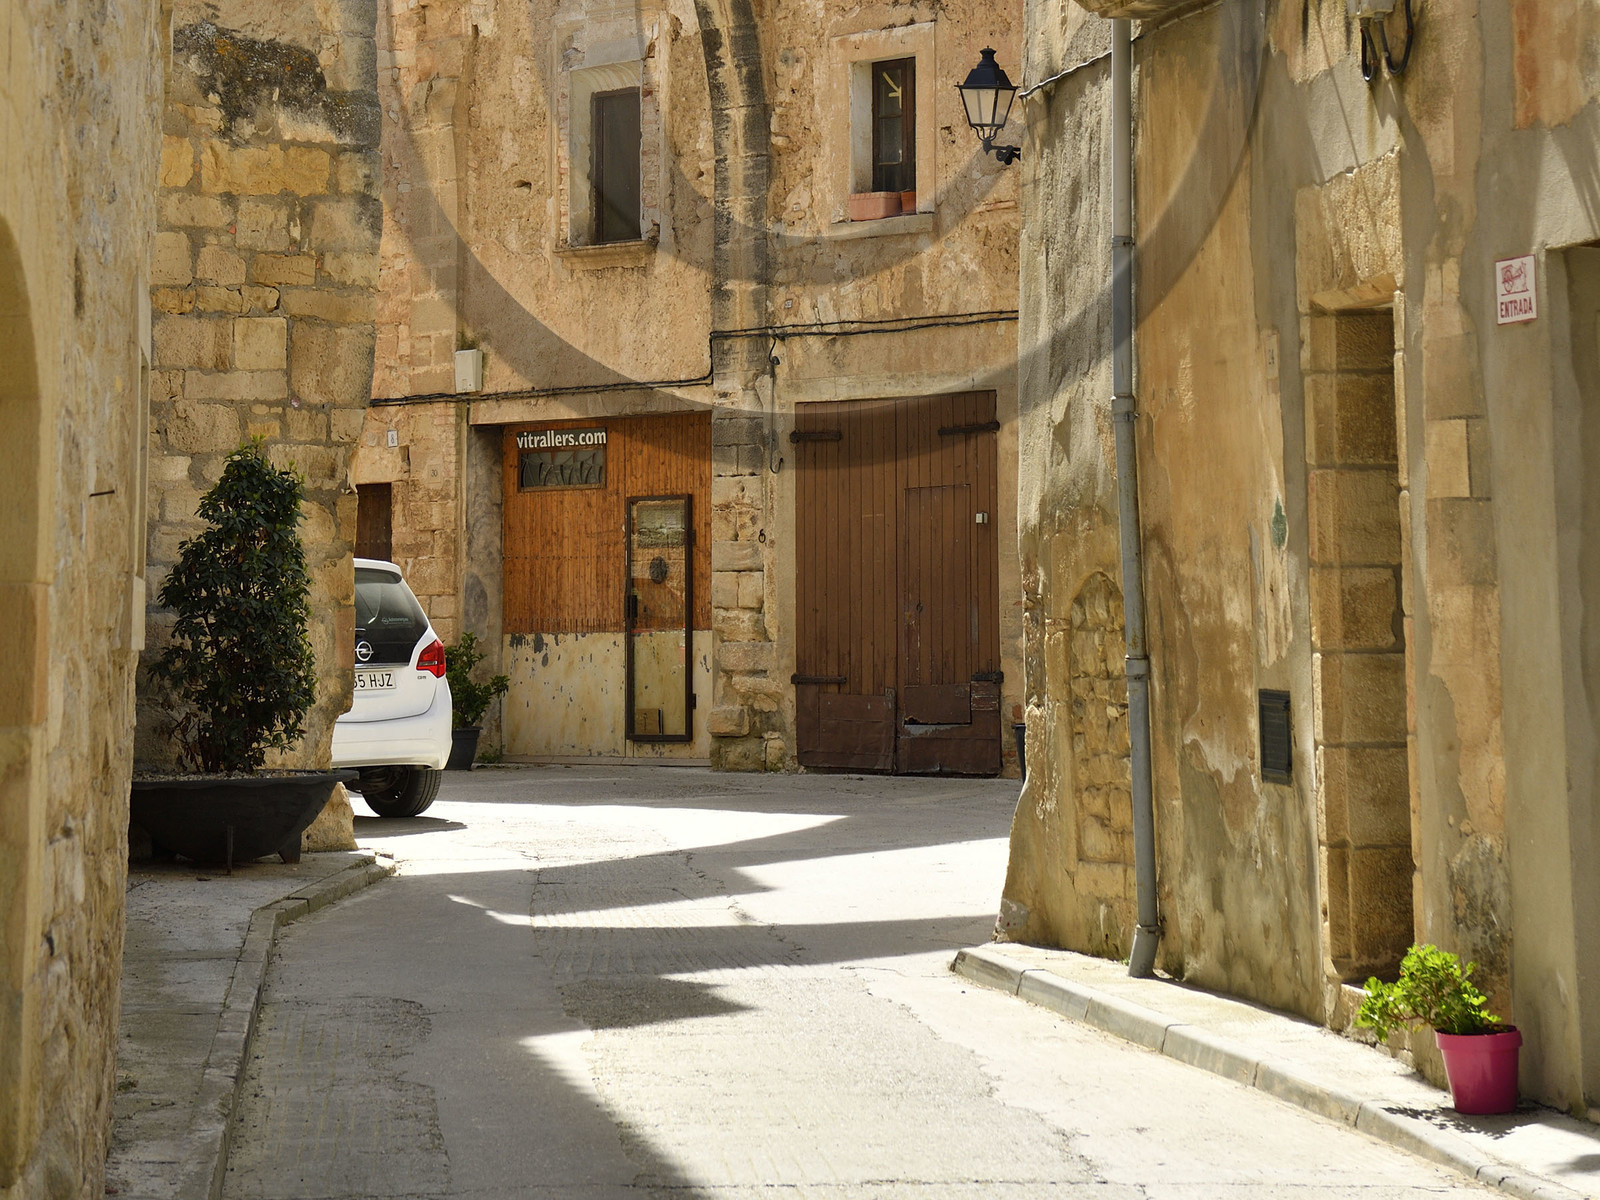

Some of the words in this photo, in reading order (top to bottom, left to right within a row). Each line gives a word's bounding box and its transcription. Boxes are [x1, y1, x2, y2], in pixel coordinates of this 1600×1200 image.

[1500, 297, 1533, 319] ENTRADA
[516, 429, 607, 449] vitrallers.com
[369, 673, 393, 688] HJZ
